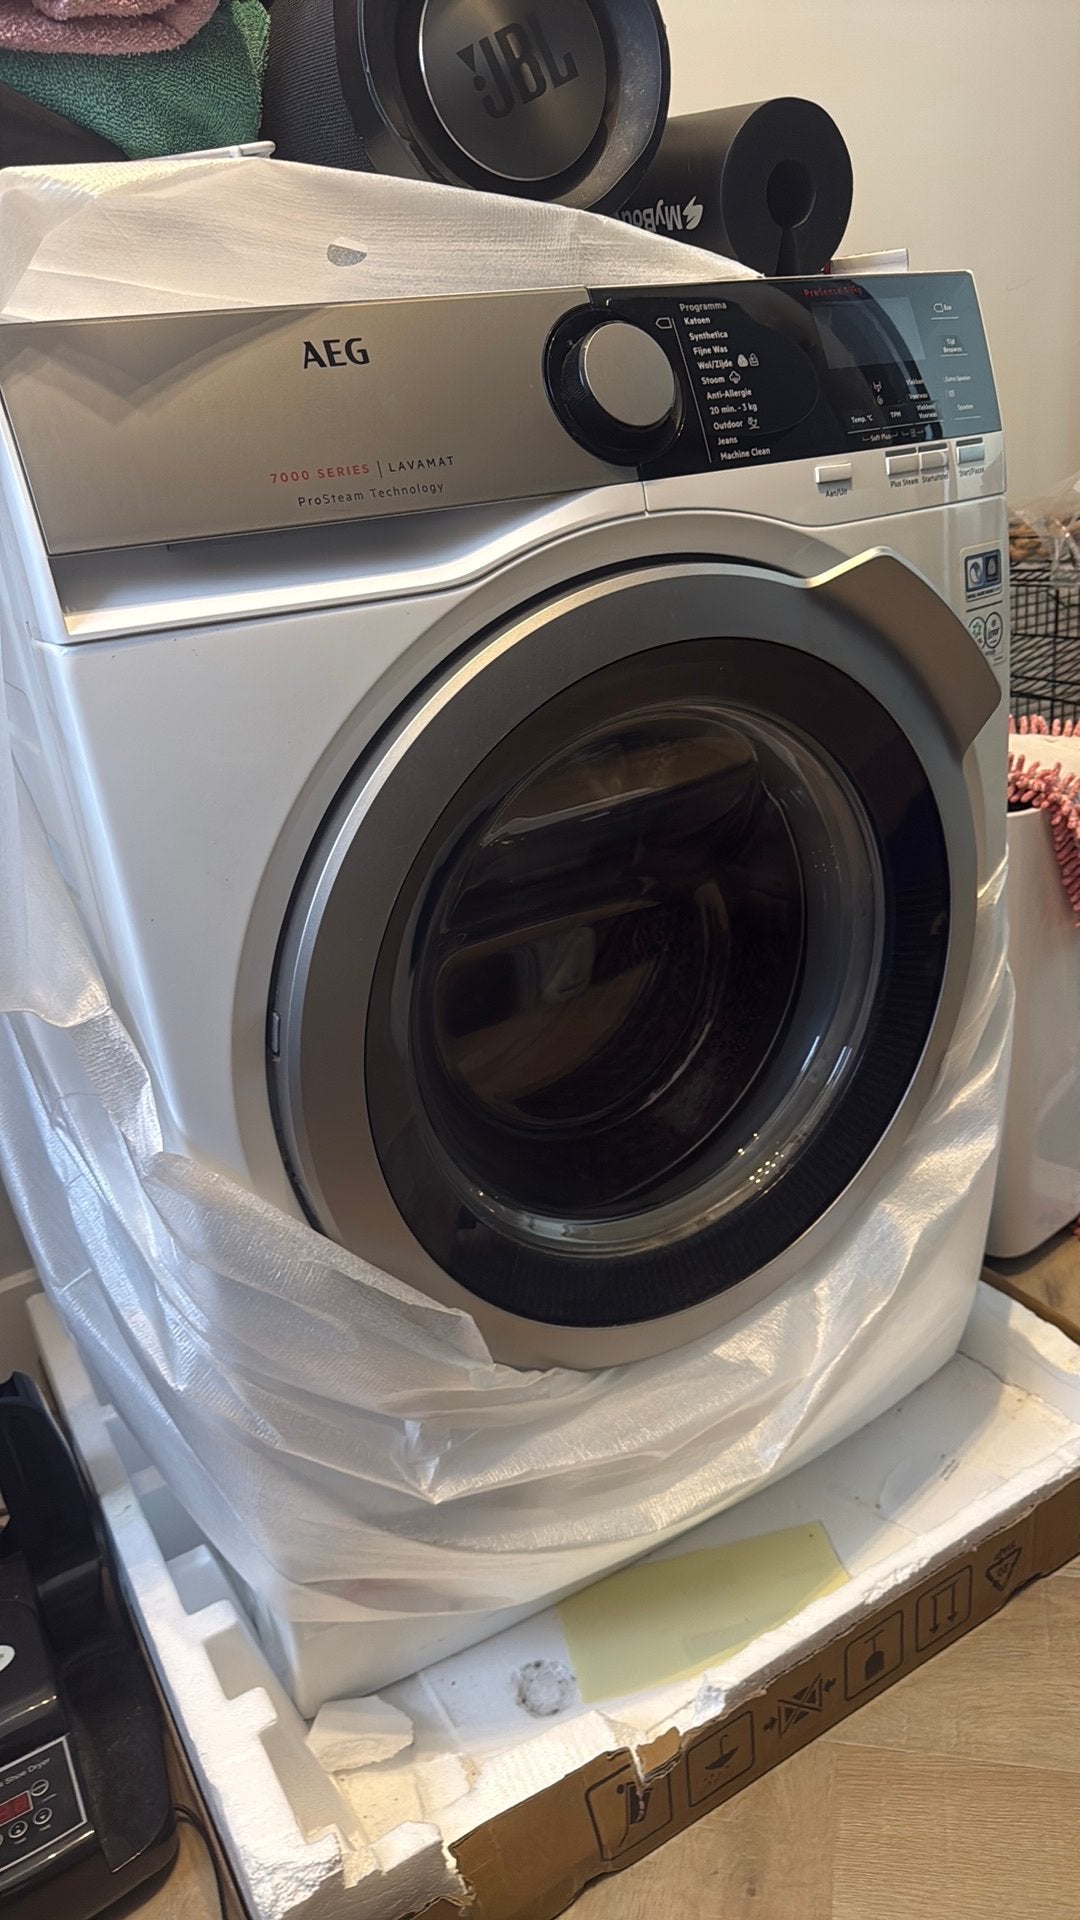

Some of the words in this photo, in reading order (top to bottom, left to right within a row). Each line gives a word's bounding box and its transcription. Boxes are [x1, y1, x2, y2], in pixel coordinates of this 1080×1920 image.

[479, 12, 579, 119] JBL
[679, 302, 727, 312] Programma
[683, 316, 711, 326] Katoen
[688, 331, 728, 341] Synthetica
[303, 337, 370, 369] AEG
[692, 347, 712, 356] Fijne
[712, 345, 728, 354] Was
[697, 359, 733, 370] Wol/Zijde
[701, 375, 725, 385] Stoom
[706, 388, 752, 400] Anti-Allergie
[709, 406, 719, 415] 20
[721, 404, 737, 413] min.
[742, 403, 747, 411] 3
[748, 402, 758, 412] kg
[713, 420, 743, 431] Outdoor
[717, 436, 738, 446] Jeans
[720, 450, 750, 461] Machine
[751, 447, 771, 457] Clean
[270, 470, 310, 484] 7000
[317, 463, 370, 479] SERIES
[388, 455, 455, 473] LAVAMAT
[902, 478, 919, 487] Steam
[298, 490, 364, 507] ProSteam
[369, 482, 444, 499] Technology
[4, 1770, 27, 1784] Shoe
[27, 1758, 50, 1773] Dryer
